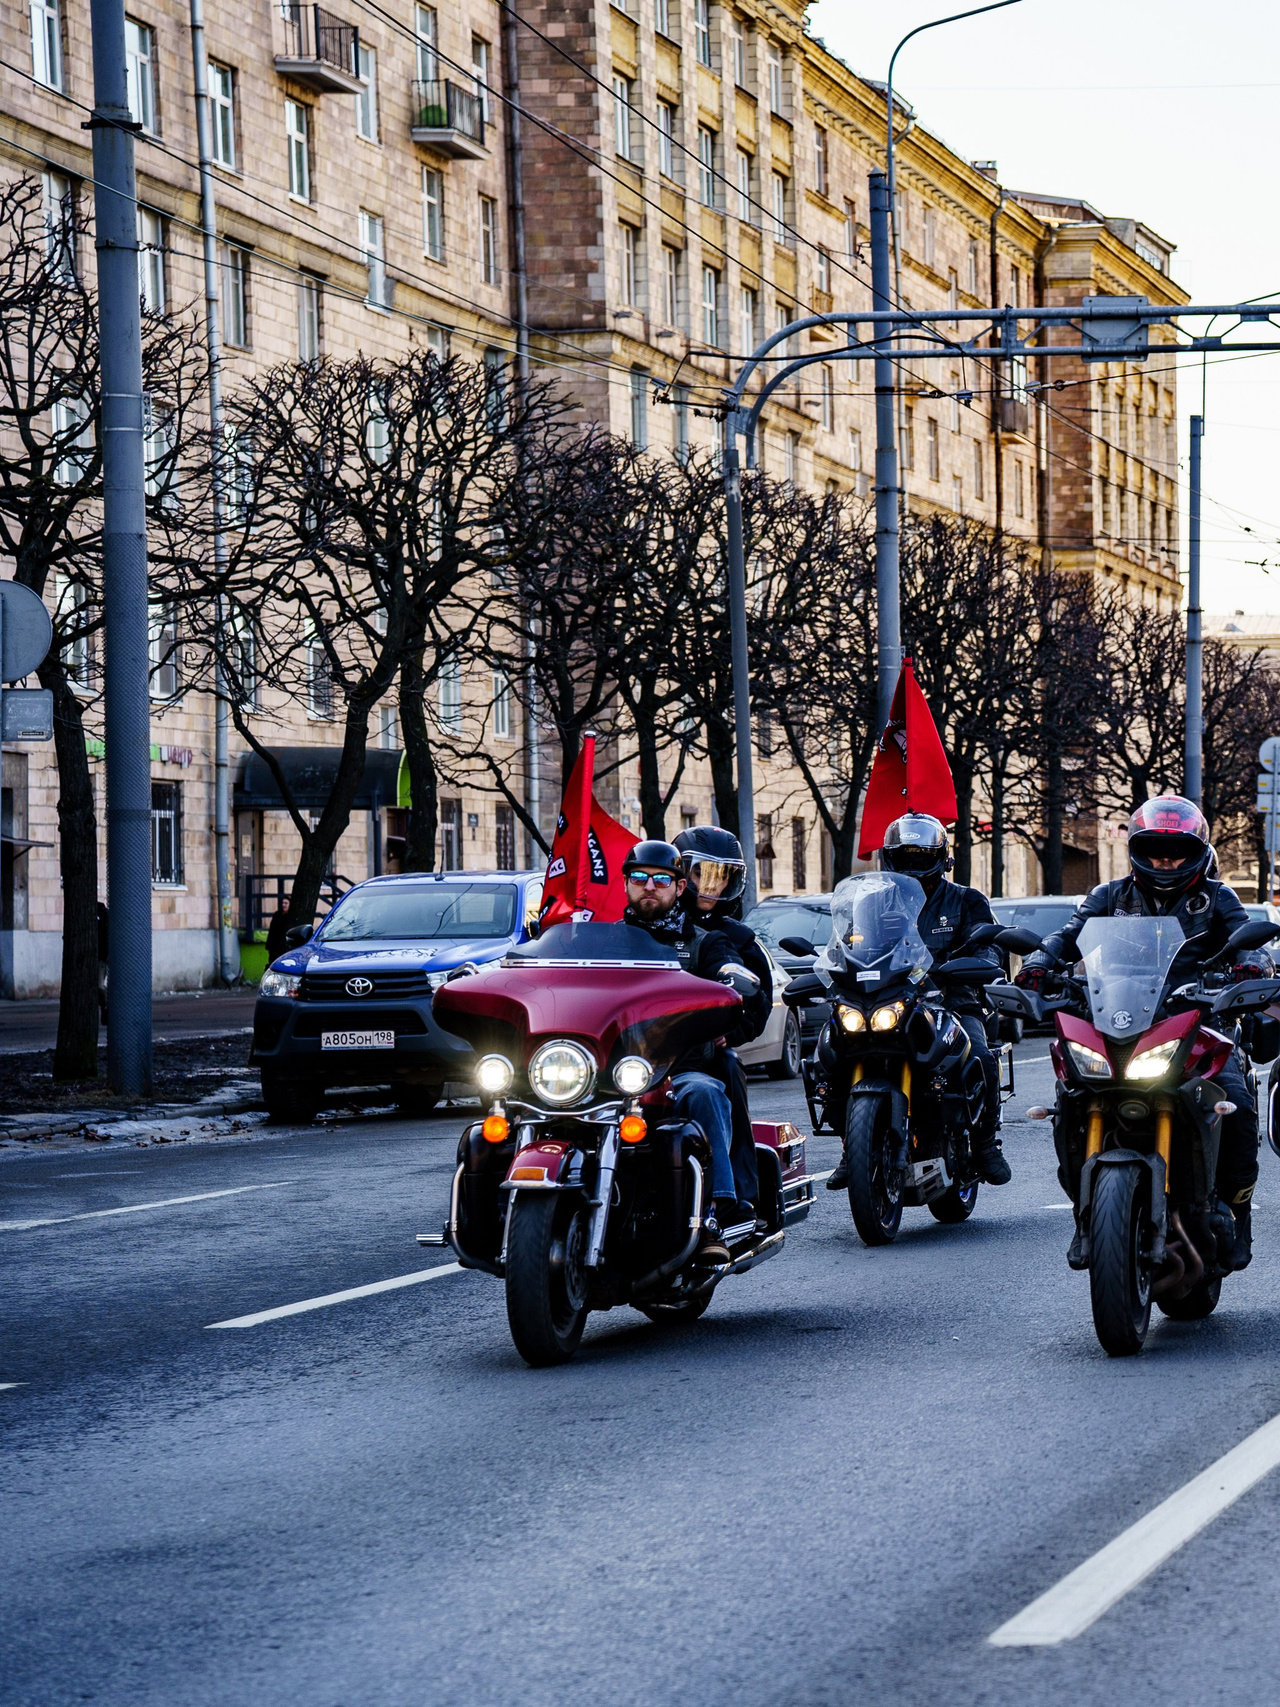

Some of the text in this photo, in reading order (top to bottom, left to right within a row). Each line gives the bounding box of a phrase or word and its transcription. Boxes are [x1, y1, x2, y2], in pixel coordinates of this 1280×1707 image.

[1156, 820, 1179, 828] SHOEI
[324, 1031, 392, 1045] А805ОН 198
